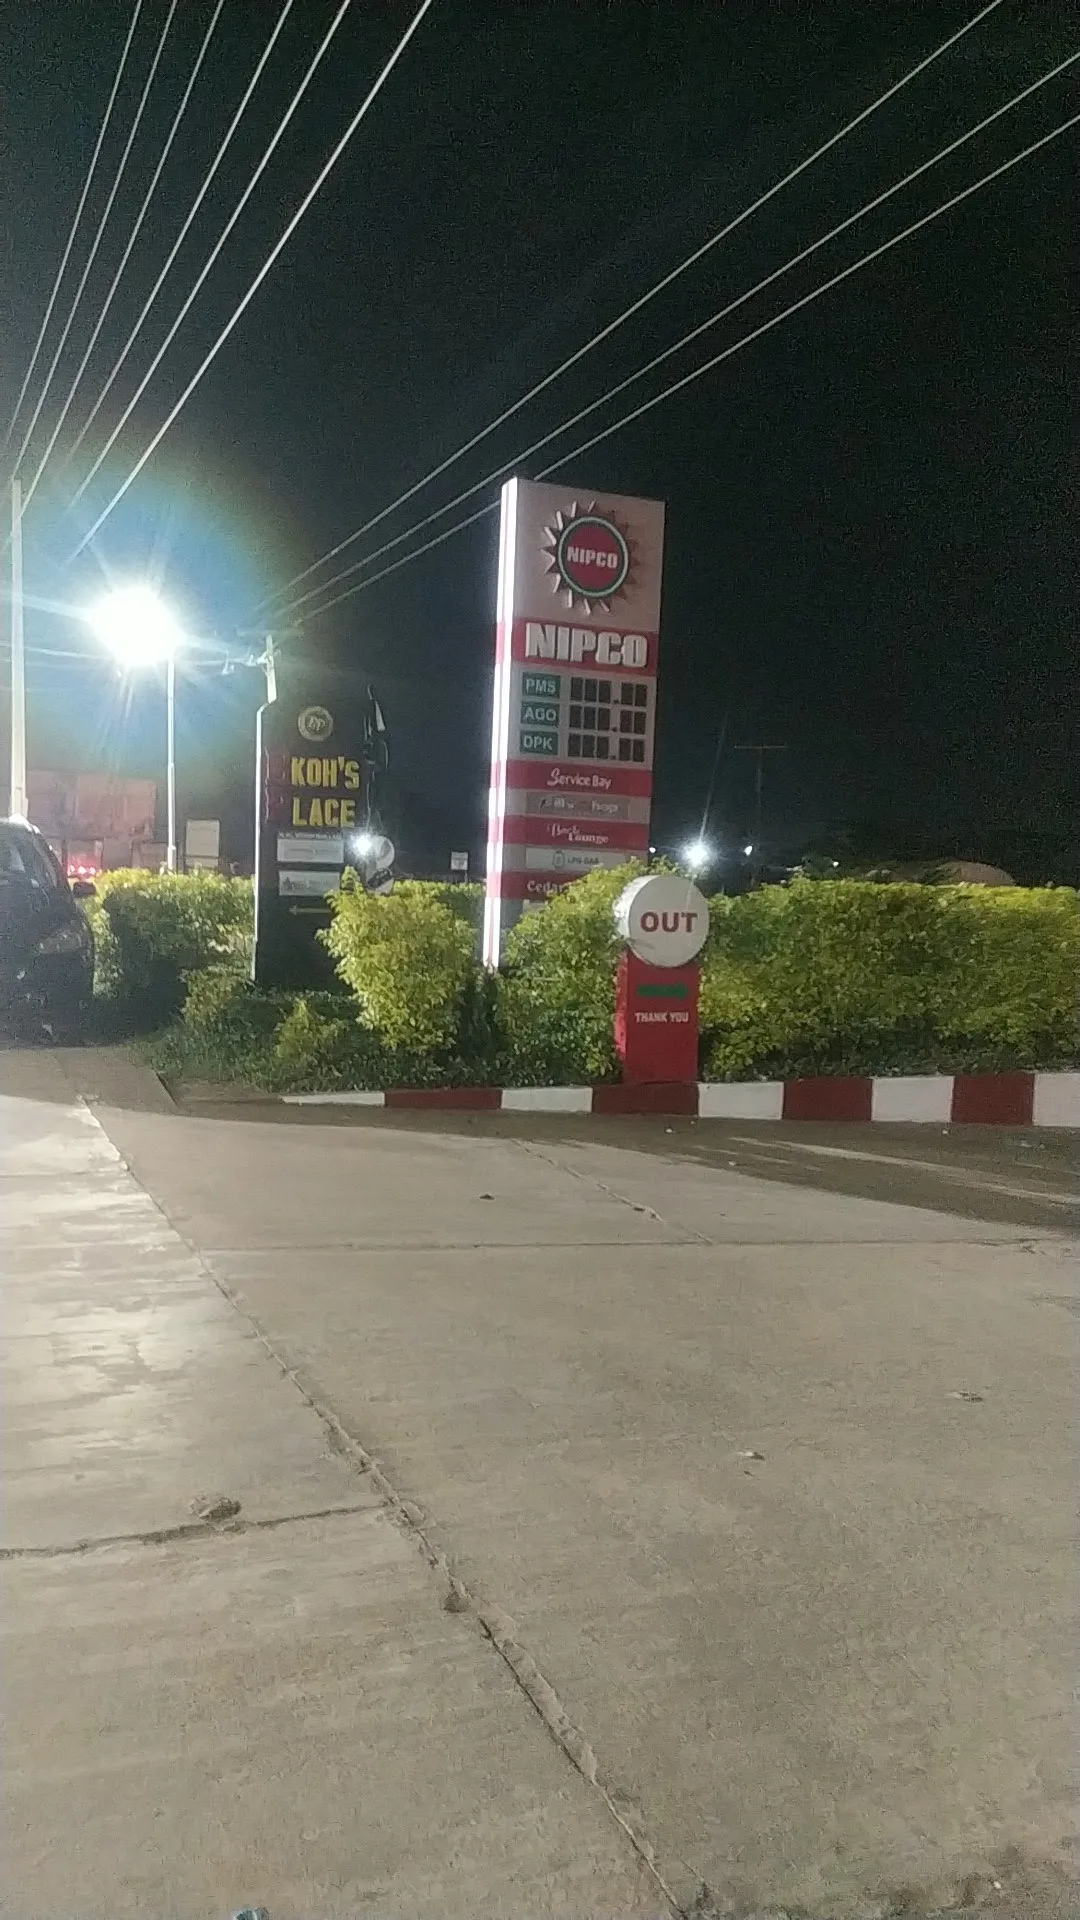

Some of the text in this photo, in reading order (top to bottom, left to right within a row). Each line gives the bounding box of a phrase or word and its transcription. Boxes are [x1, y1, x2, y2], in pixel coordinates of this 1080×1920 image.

[566, 546, 618, 569] NIPCO
[525, 622, 648, 668] NIPCO
[525, 678, 557, 694] PMS
[524, 706, 557, 721] AGO
[523, 734, 553, 750] DPK
[291, 755, 360, 789] KOH'S
[547, 767, 612, 790] Service Bay
[292, 796, 356, 828] LACE
[640, 911, 698, 933] OUT
[634, 1011, 689, 1023] THANK YOU
